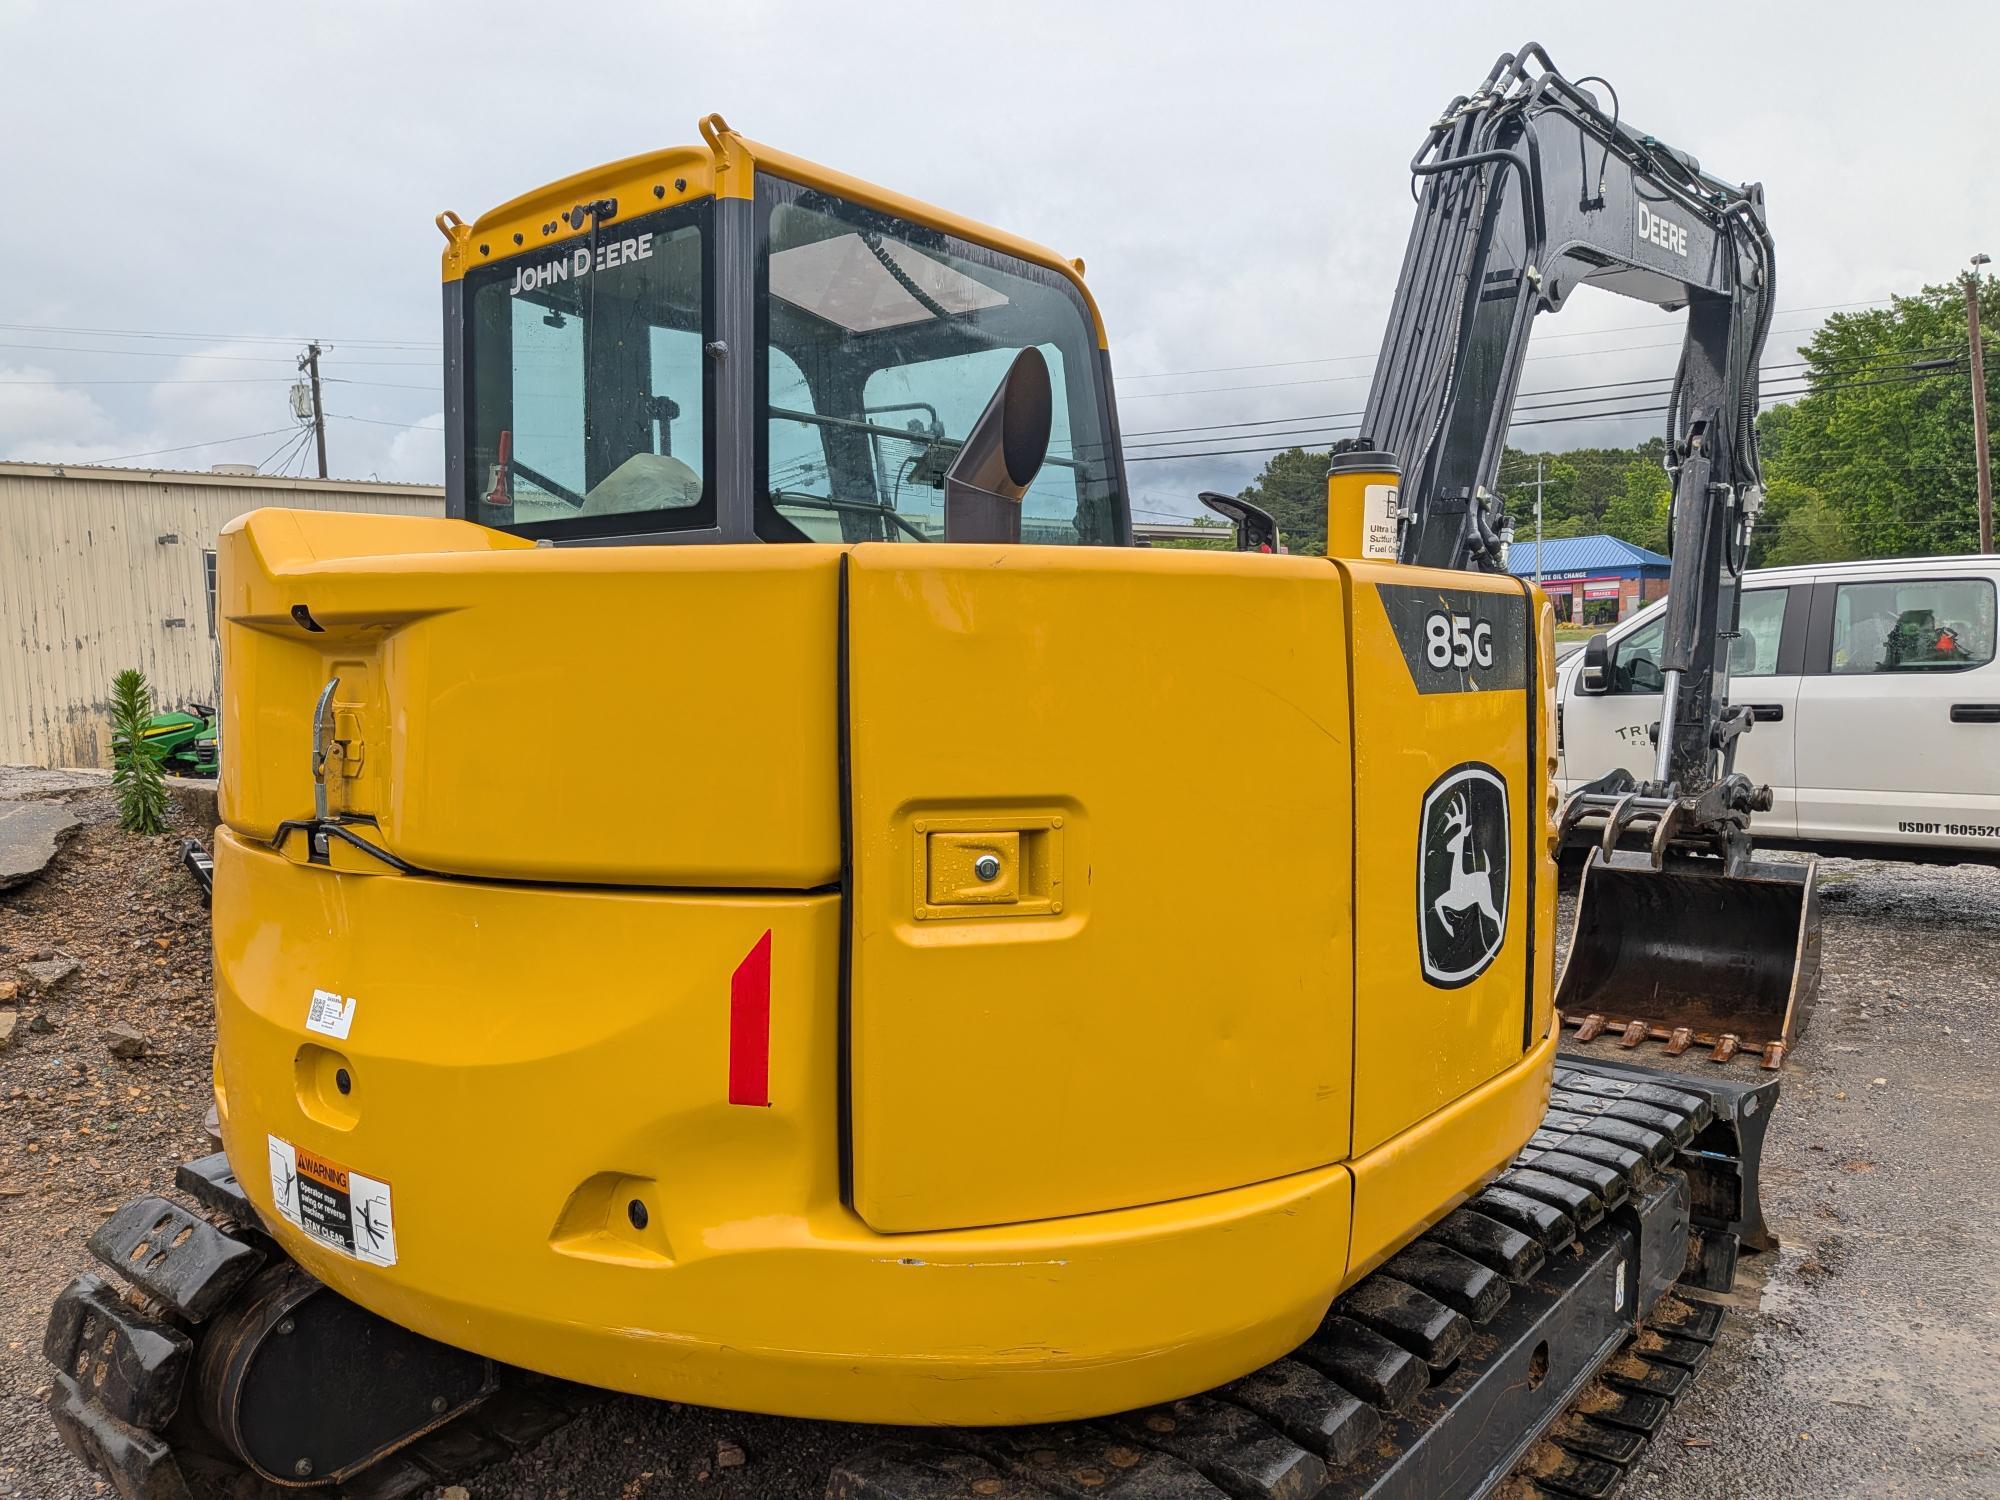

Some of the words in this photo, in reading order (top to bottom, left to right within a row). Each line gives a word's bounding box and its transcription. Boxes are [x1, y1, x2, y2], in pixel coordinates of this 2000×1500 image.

[1638, 201, 1688, 257] DEERE
[509, 258, 568, 296] JOHN
[574, 232, 653, 278] DEERE
[1370, 524, 1389, 533] Ultra
[1369, 544, 1386, 553] Fuel
[1425, 612, 1494, 669] 85G
[1615, 724, 1649, 740] TRI
[1898, 821, 1941, 834] USDOT
[304, 1158, 347, 1188] WARNING
[300, 1181, 324, 1200] Operator
[324, 1194, 337, 1208] may
[302, 1205, 325, 1220] machine
[317, 1201, 324, 1211] or
[324, 1205, 346, 1220] reverse
[304, 1217, 321, 1233] STAY
[321, 1226, 346, 1246] CLEAR
